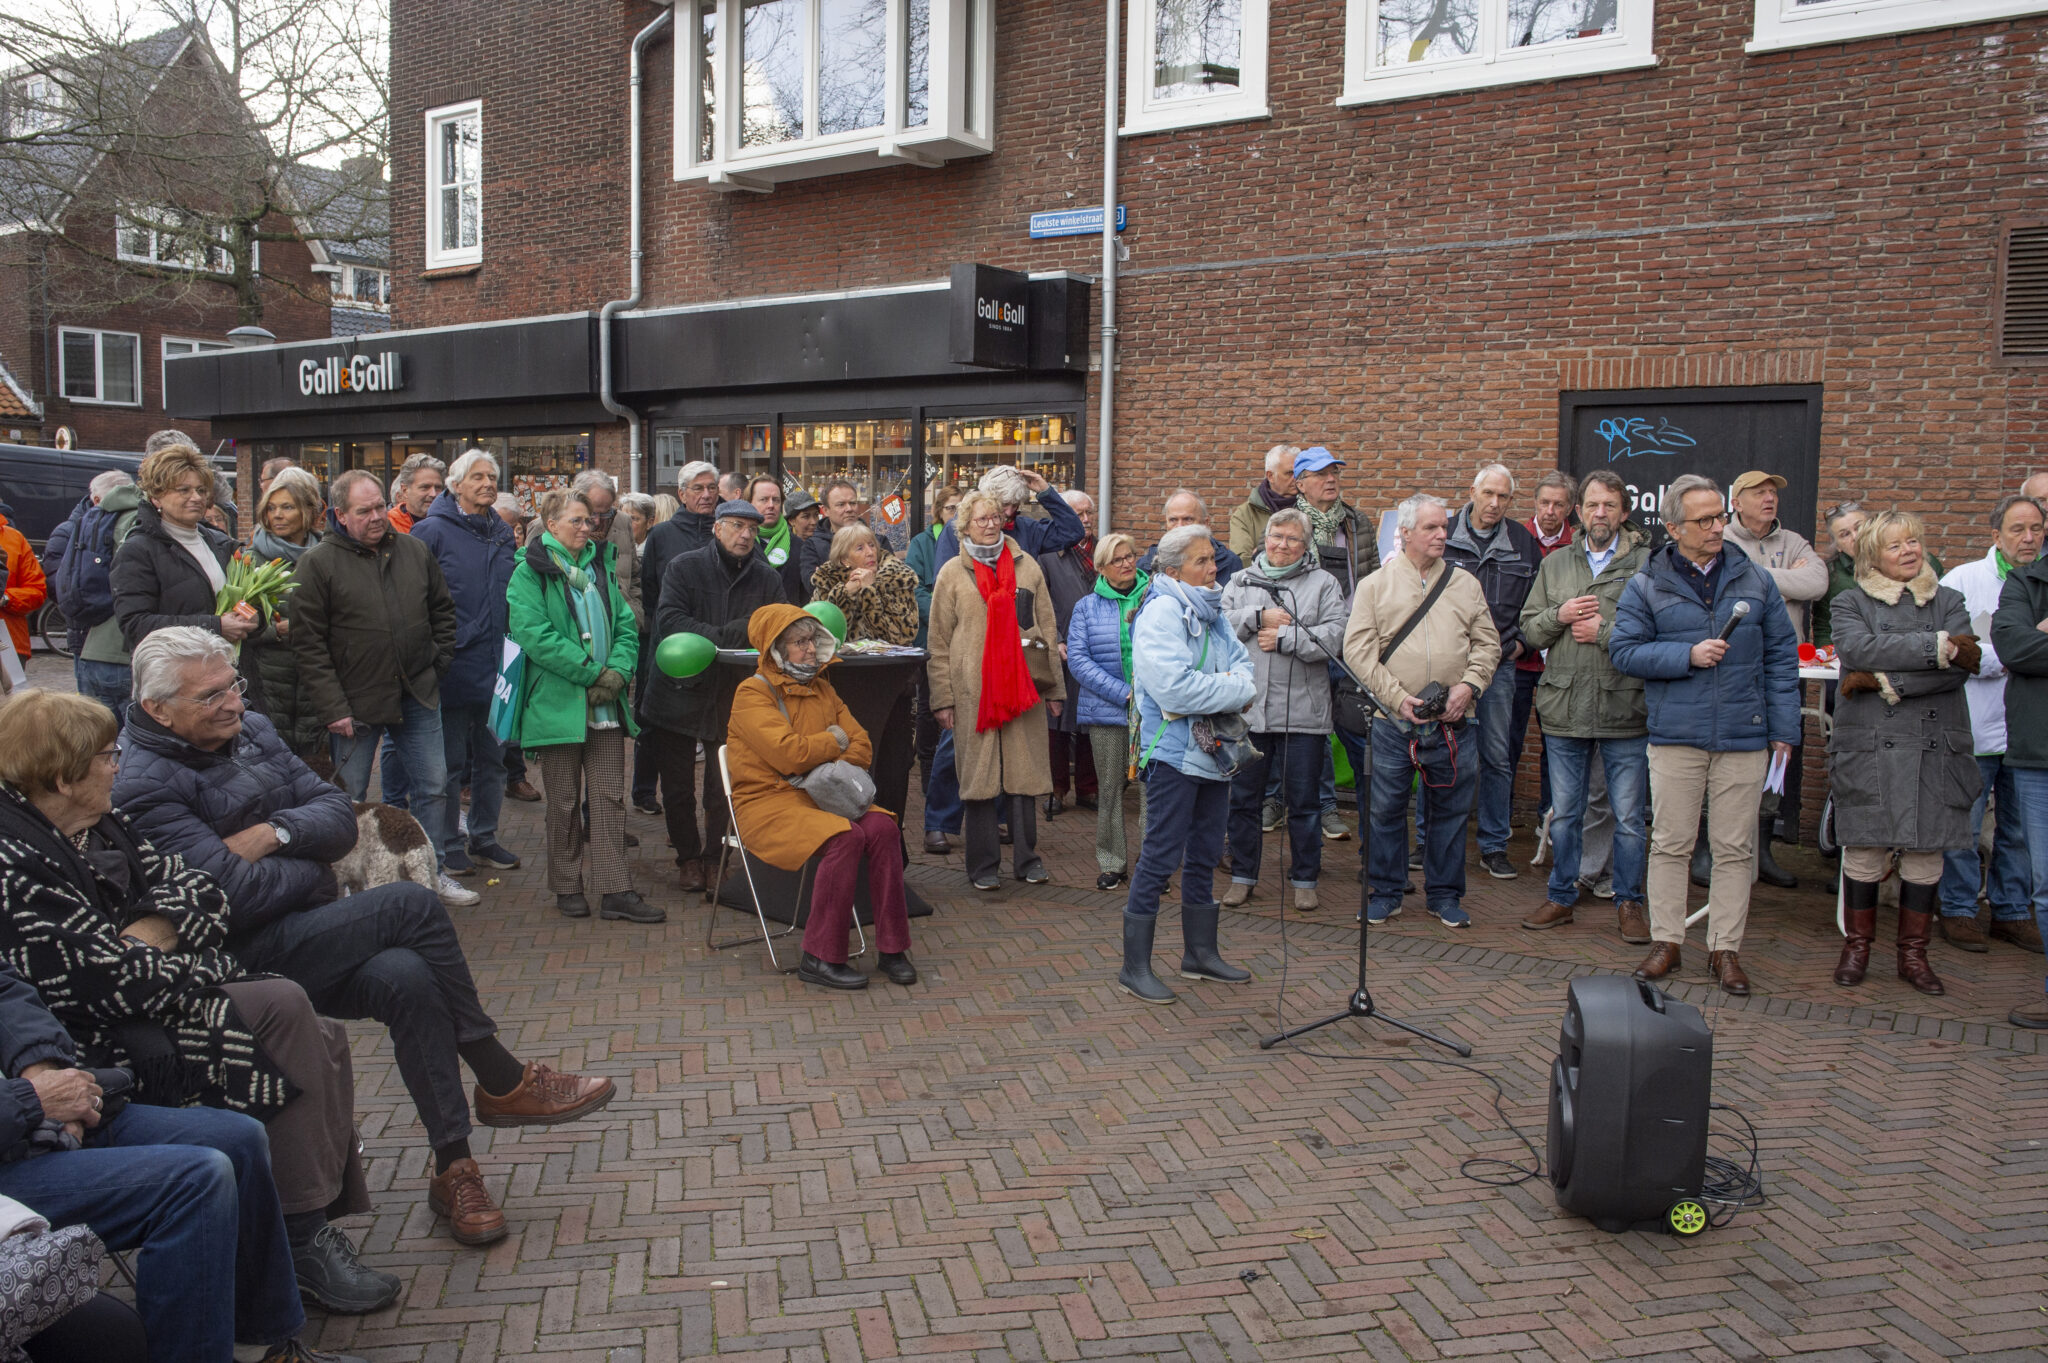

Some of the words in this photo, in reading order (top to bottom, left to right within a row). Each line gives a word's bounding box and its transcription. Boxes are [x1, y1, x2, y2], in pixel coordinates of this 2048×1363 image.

[1033, 218, 1059, 229] Leukste
[1060, 214, 1103, 226] winkelstraat
[494, 673, 513, 704] DA
